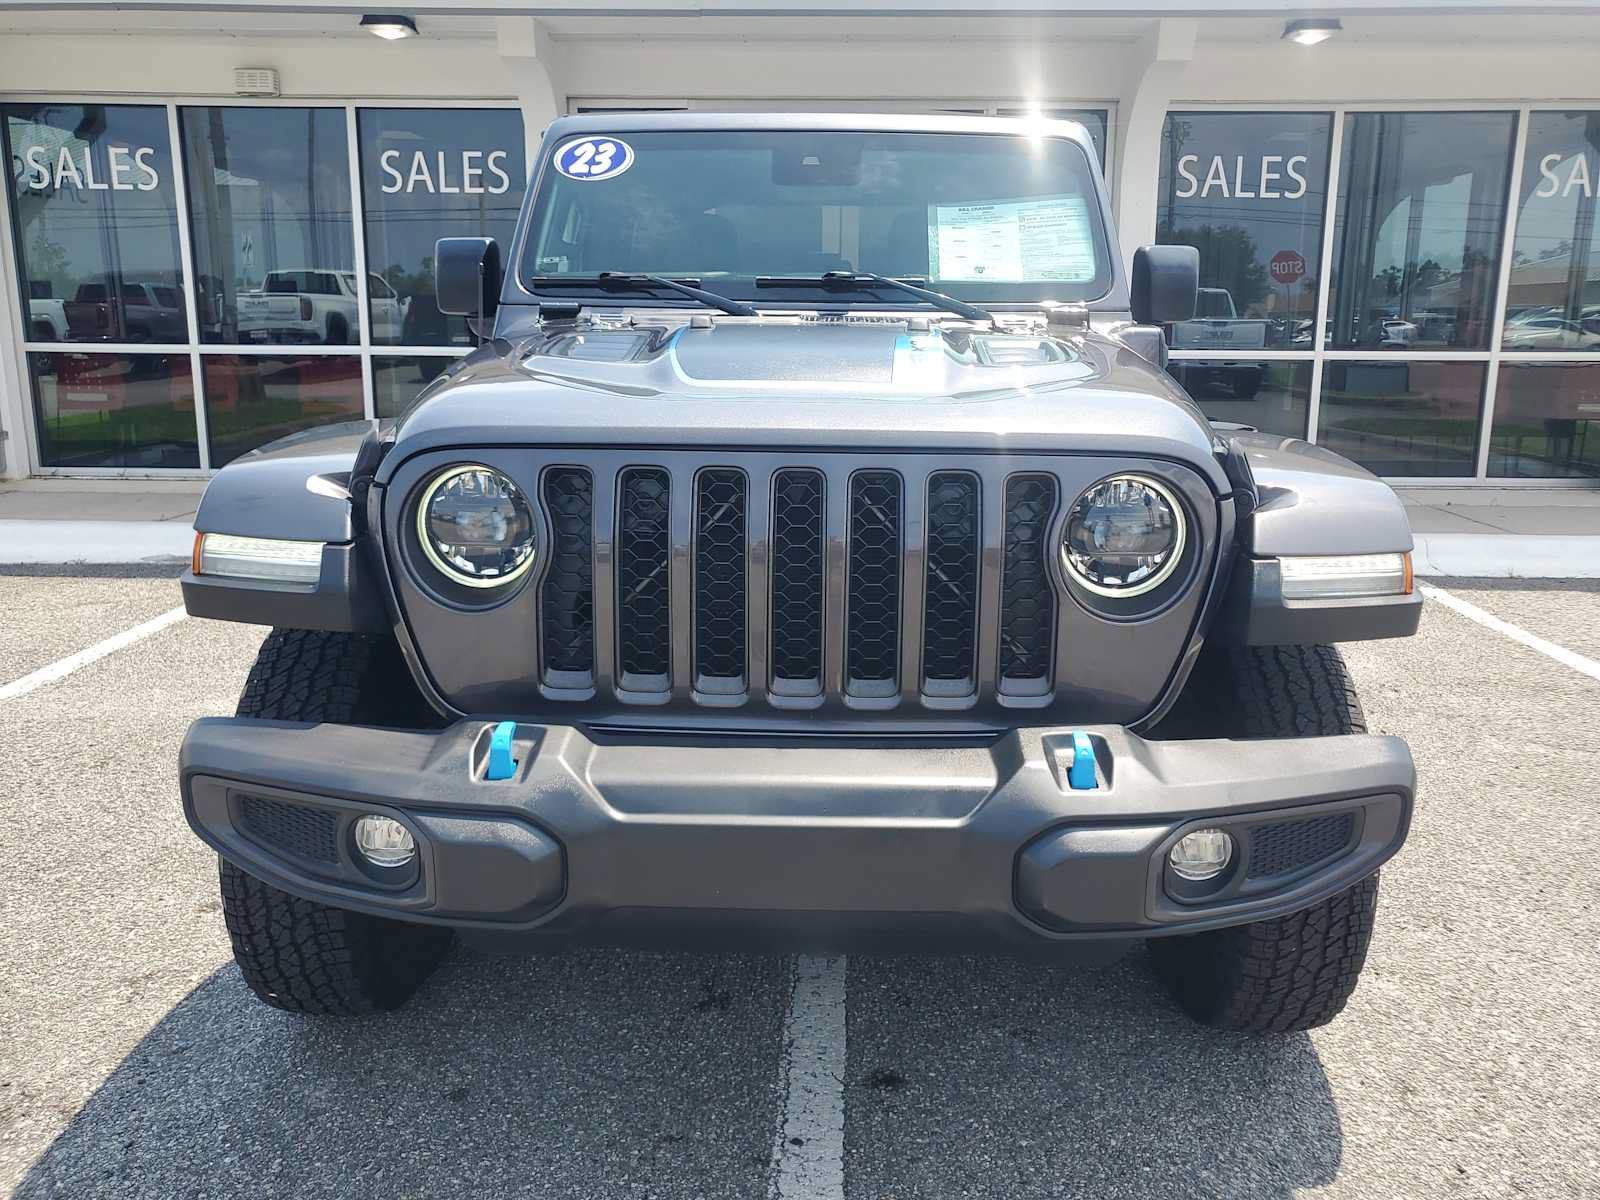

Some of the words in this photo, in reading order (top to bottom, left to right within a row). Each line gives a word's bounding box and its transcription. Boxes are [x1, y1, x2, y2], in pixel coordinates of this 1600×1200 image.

[26, 146, 159, 191] SALES
[379, 150, 510, 194] SALES
[568, 142, 616, 174] 23
[1175, 154, 1308, 199] SALES
[1535, 152, 1600, 198] SA
